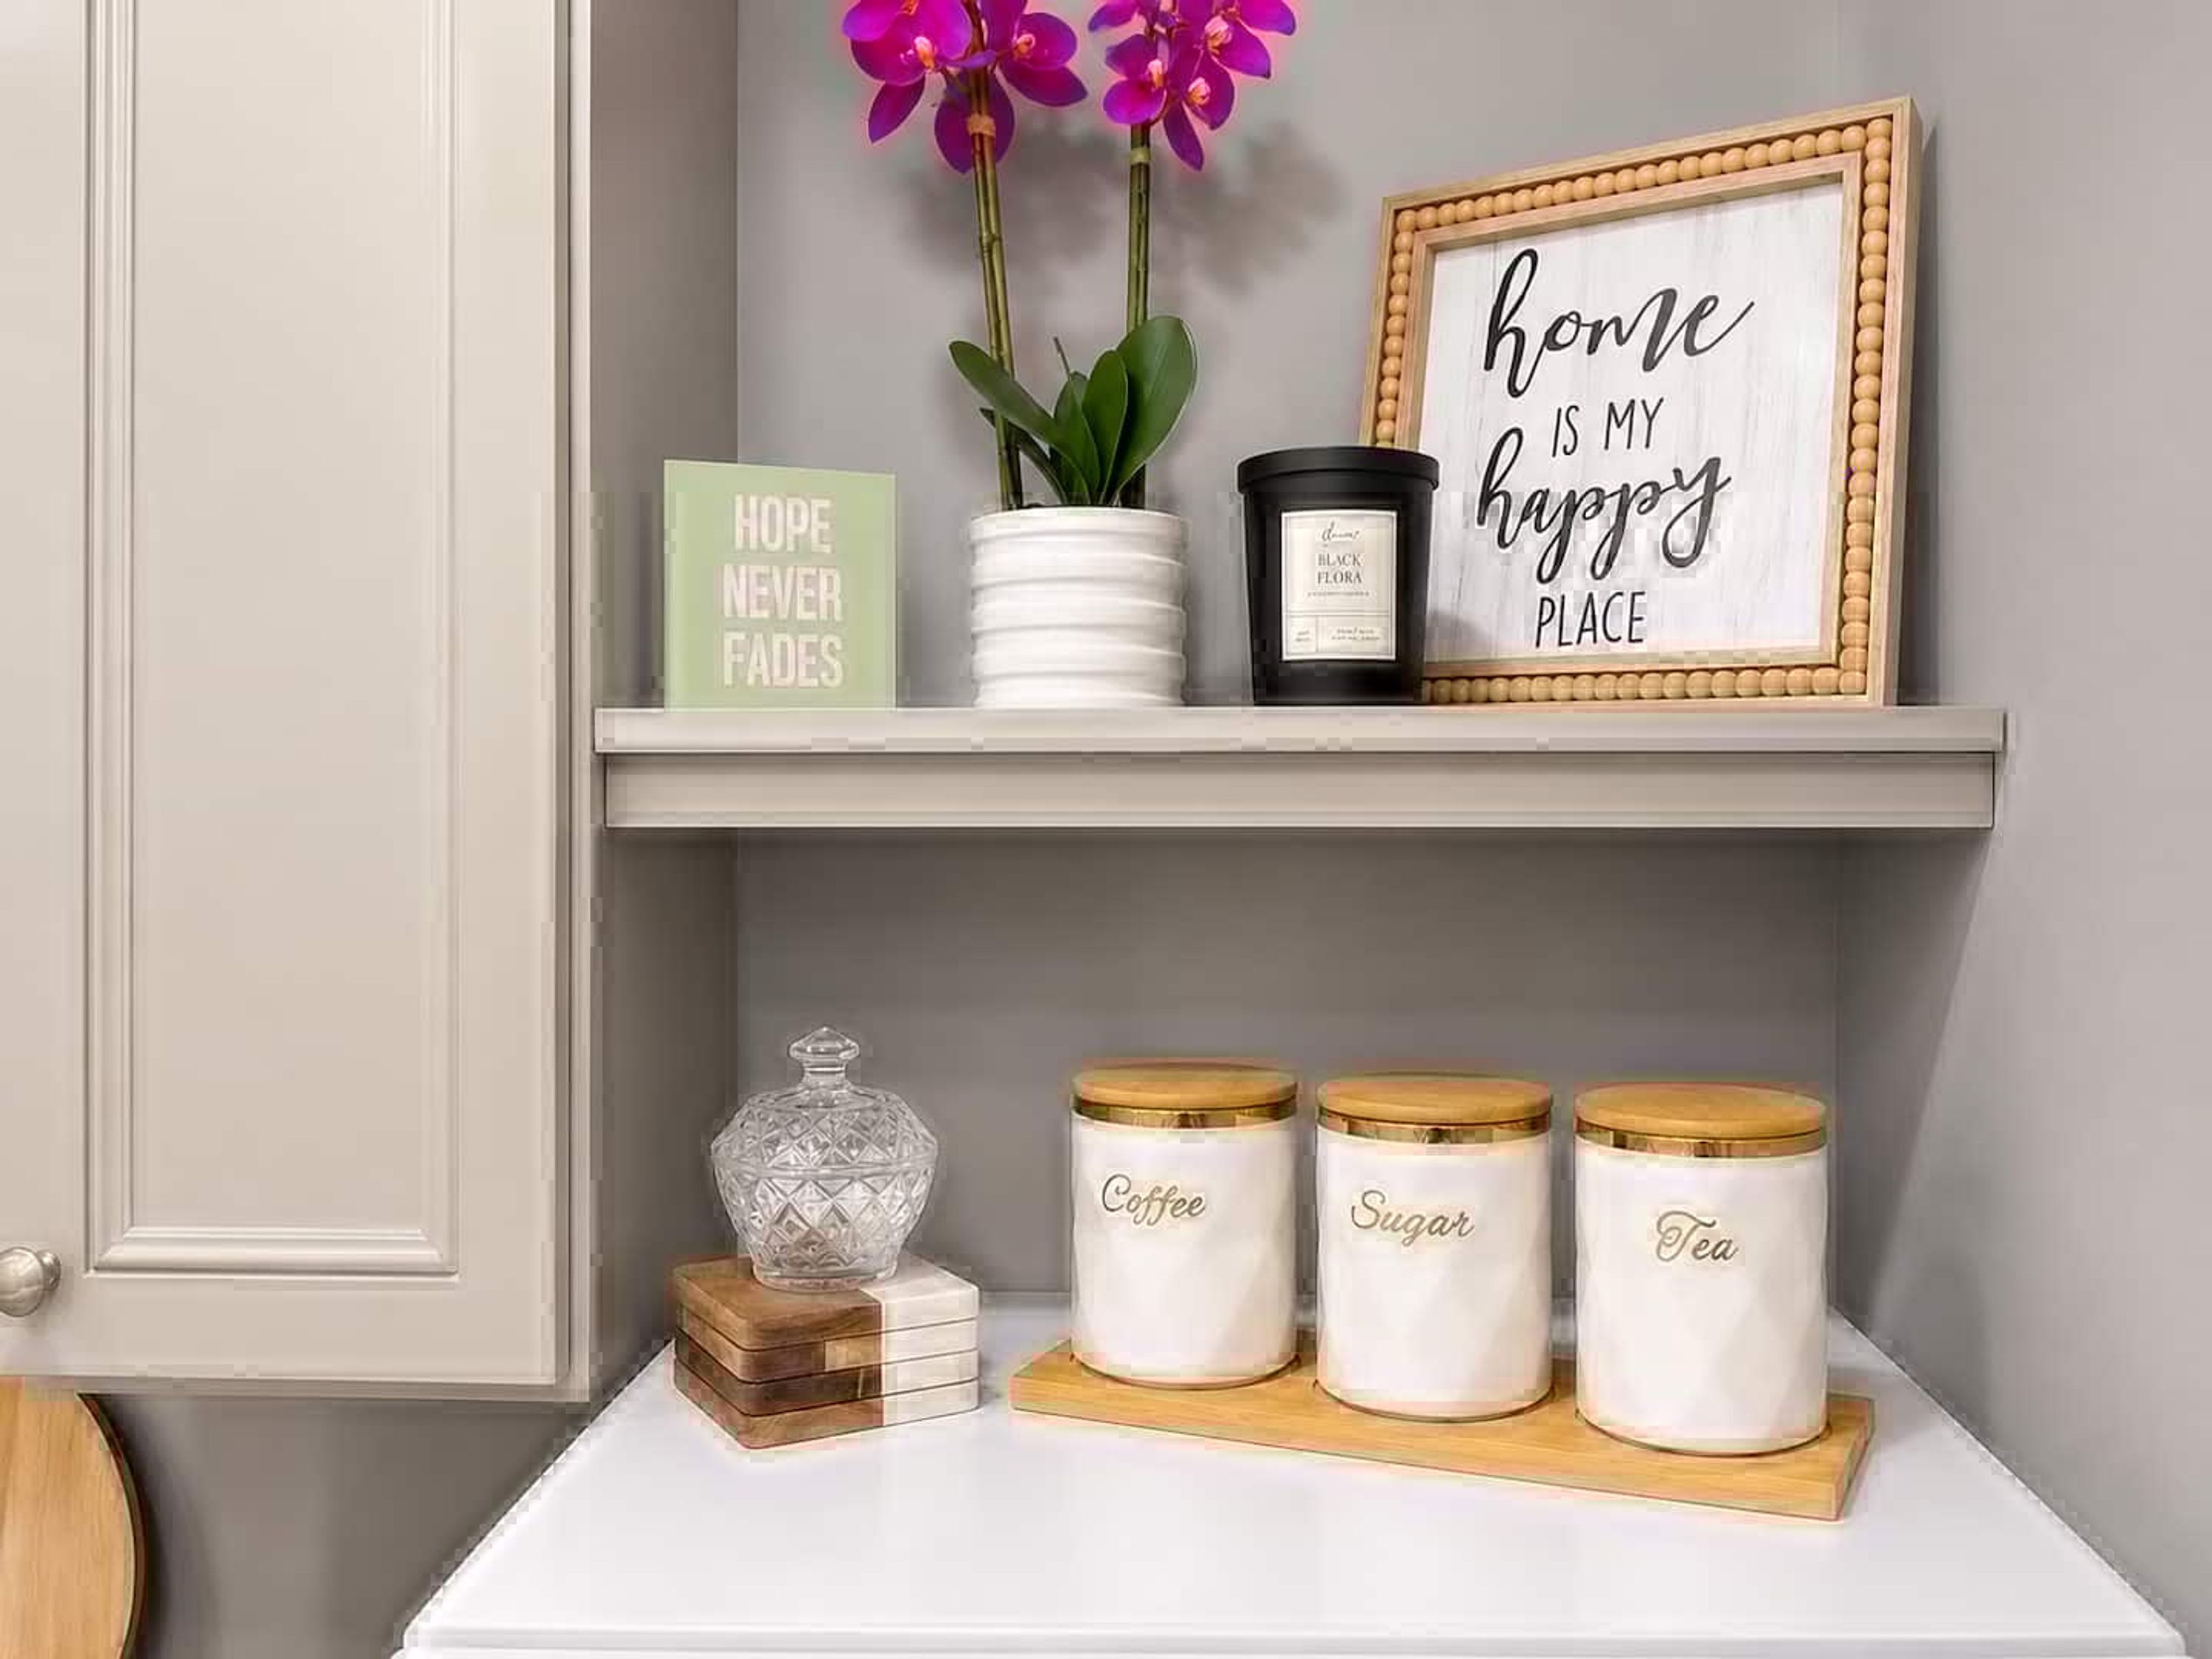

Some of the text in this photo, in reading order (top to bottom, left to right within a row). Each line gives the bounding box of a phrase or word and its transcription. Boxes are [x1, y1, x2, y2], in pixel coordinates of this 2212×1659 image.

[1484, 248, 1755, 398] home
[1551, 397, 1664, 457] IS MY
[734, 494, 832, 553] HOPE
[1476, 427, 1732, 584] happy
[1317, 571, 1363, 585] FLORA
[1318, 553, 1362, 566] BLACK
[723, 563, 843, 622] NEVER
[1536, 591, 1647, 648] PLACE
[723, 631, 844, 689] FADES
[1101, 1173, 1206, 1225] Coffee
[1351, 1189, 1475, 1247] Sugar
[1656, 1210, 1739, 1262] Tea
